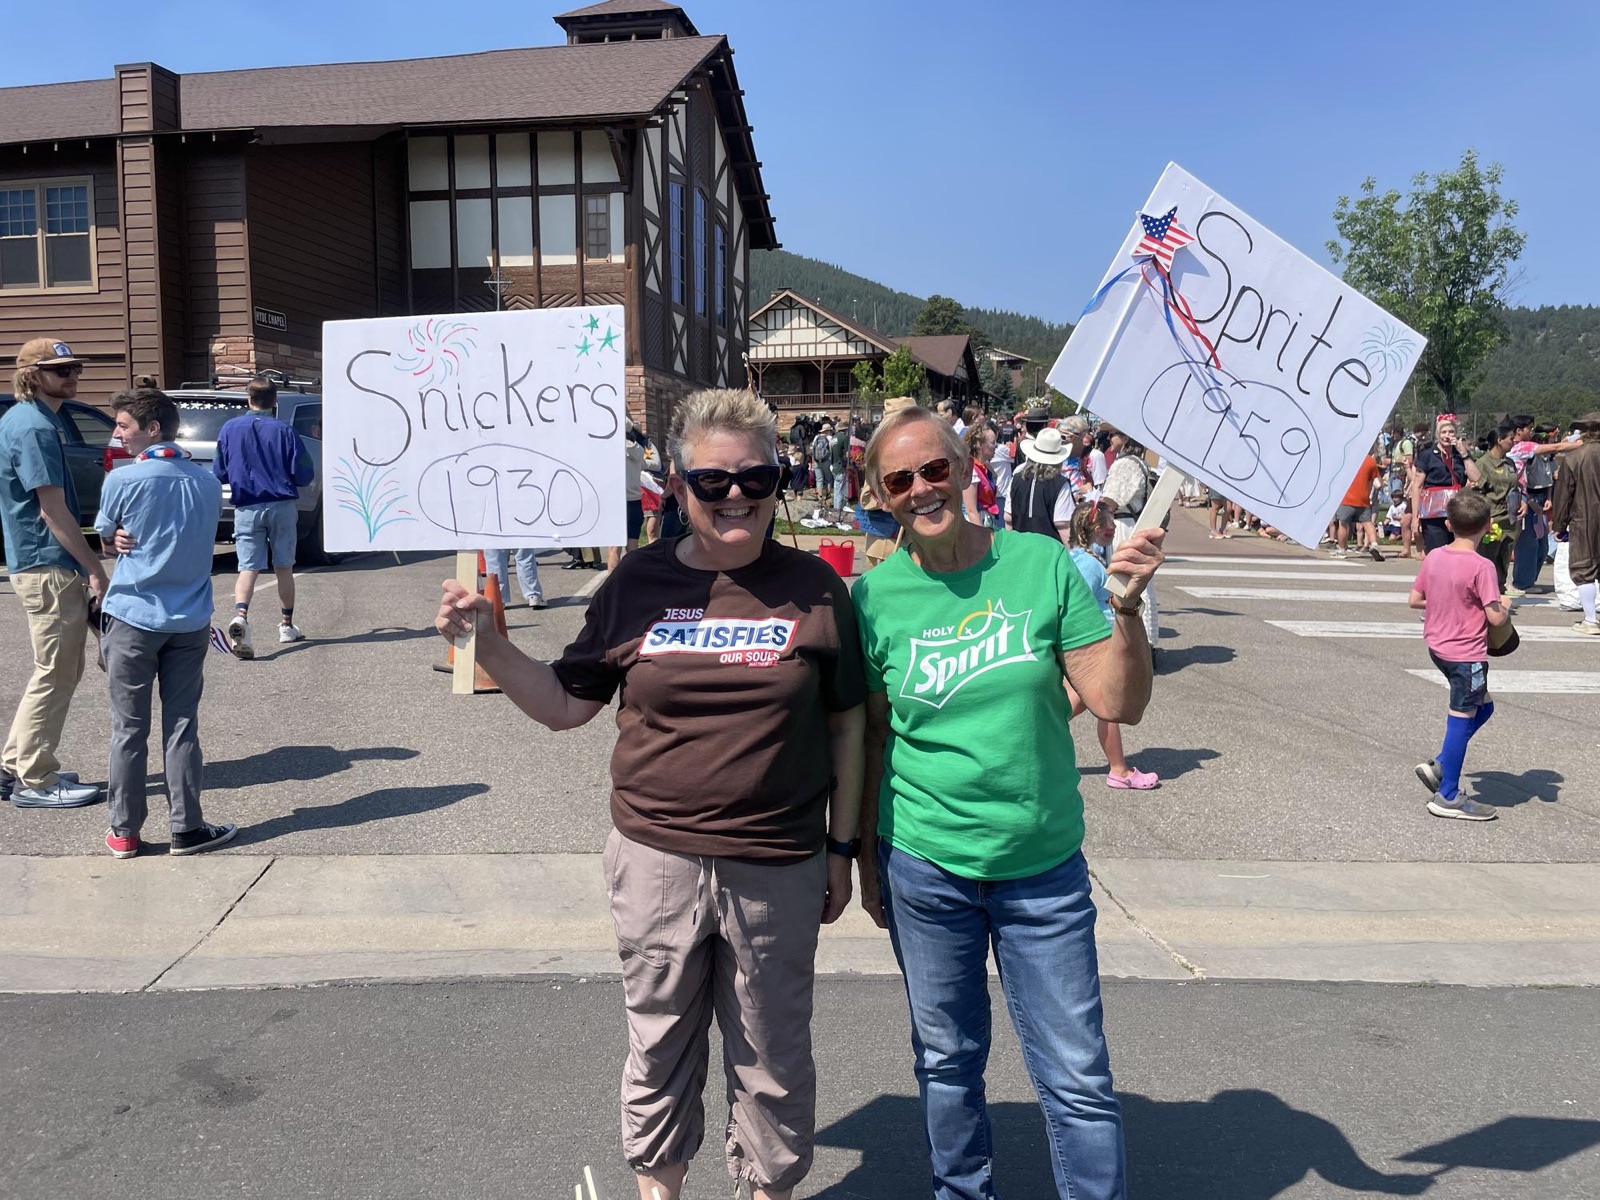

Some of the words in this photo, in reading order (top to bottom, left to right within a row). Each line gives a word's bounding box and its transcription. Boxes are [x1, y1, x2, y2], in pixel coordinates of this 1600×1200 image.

[268, 313, 285, 327] CHAPEL
[1168, 211, 1372, 418] Sprite
[346, 343, 618, 466] Snickers
[1162, 373, 1311, 505] 1959
[446, 465, 583, 537] 1930
[650, 624, 788, 648] SATISFIES
[663, 608, 704, 620] JESUS
[922, 626, 955, 639] HOLY
[719, 652, 742, 664] OUR
[745, 651, 780, 663] SOULS
[914, 618, 1015, 695] Spirit
